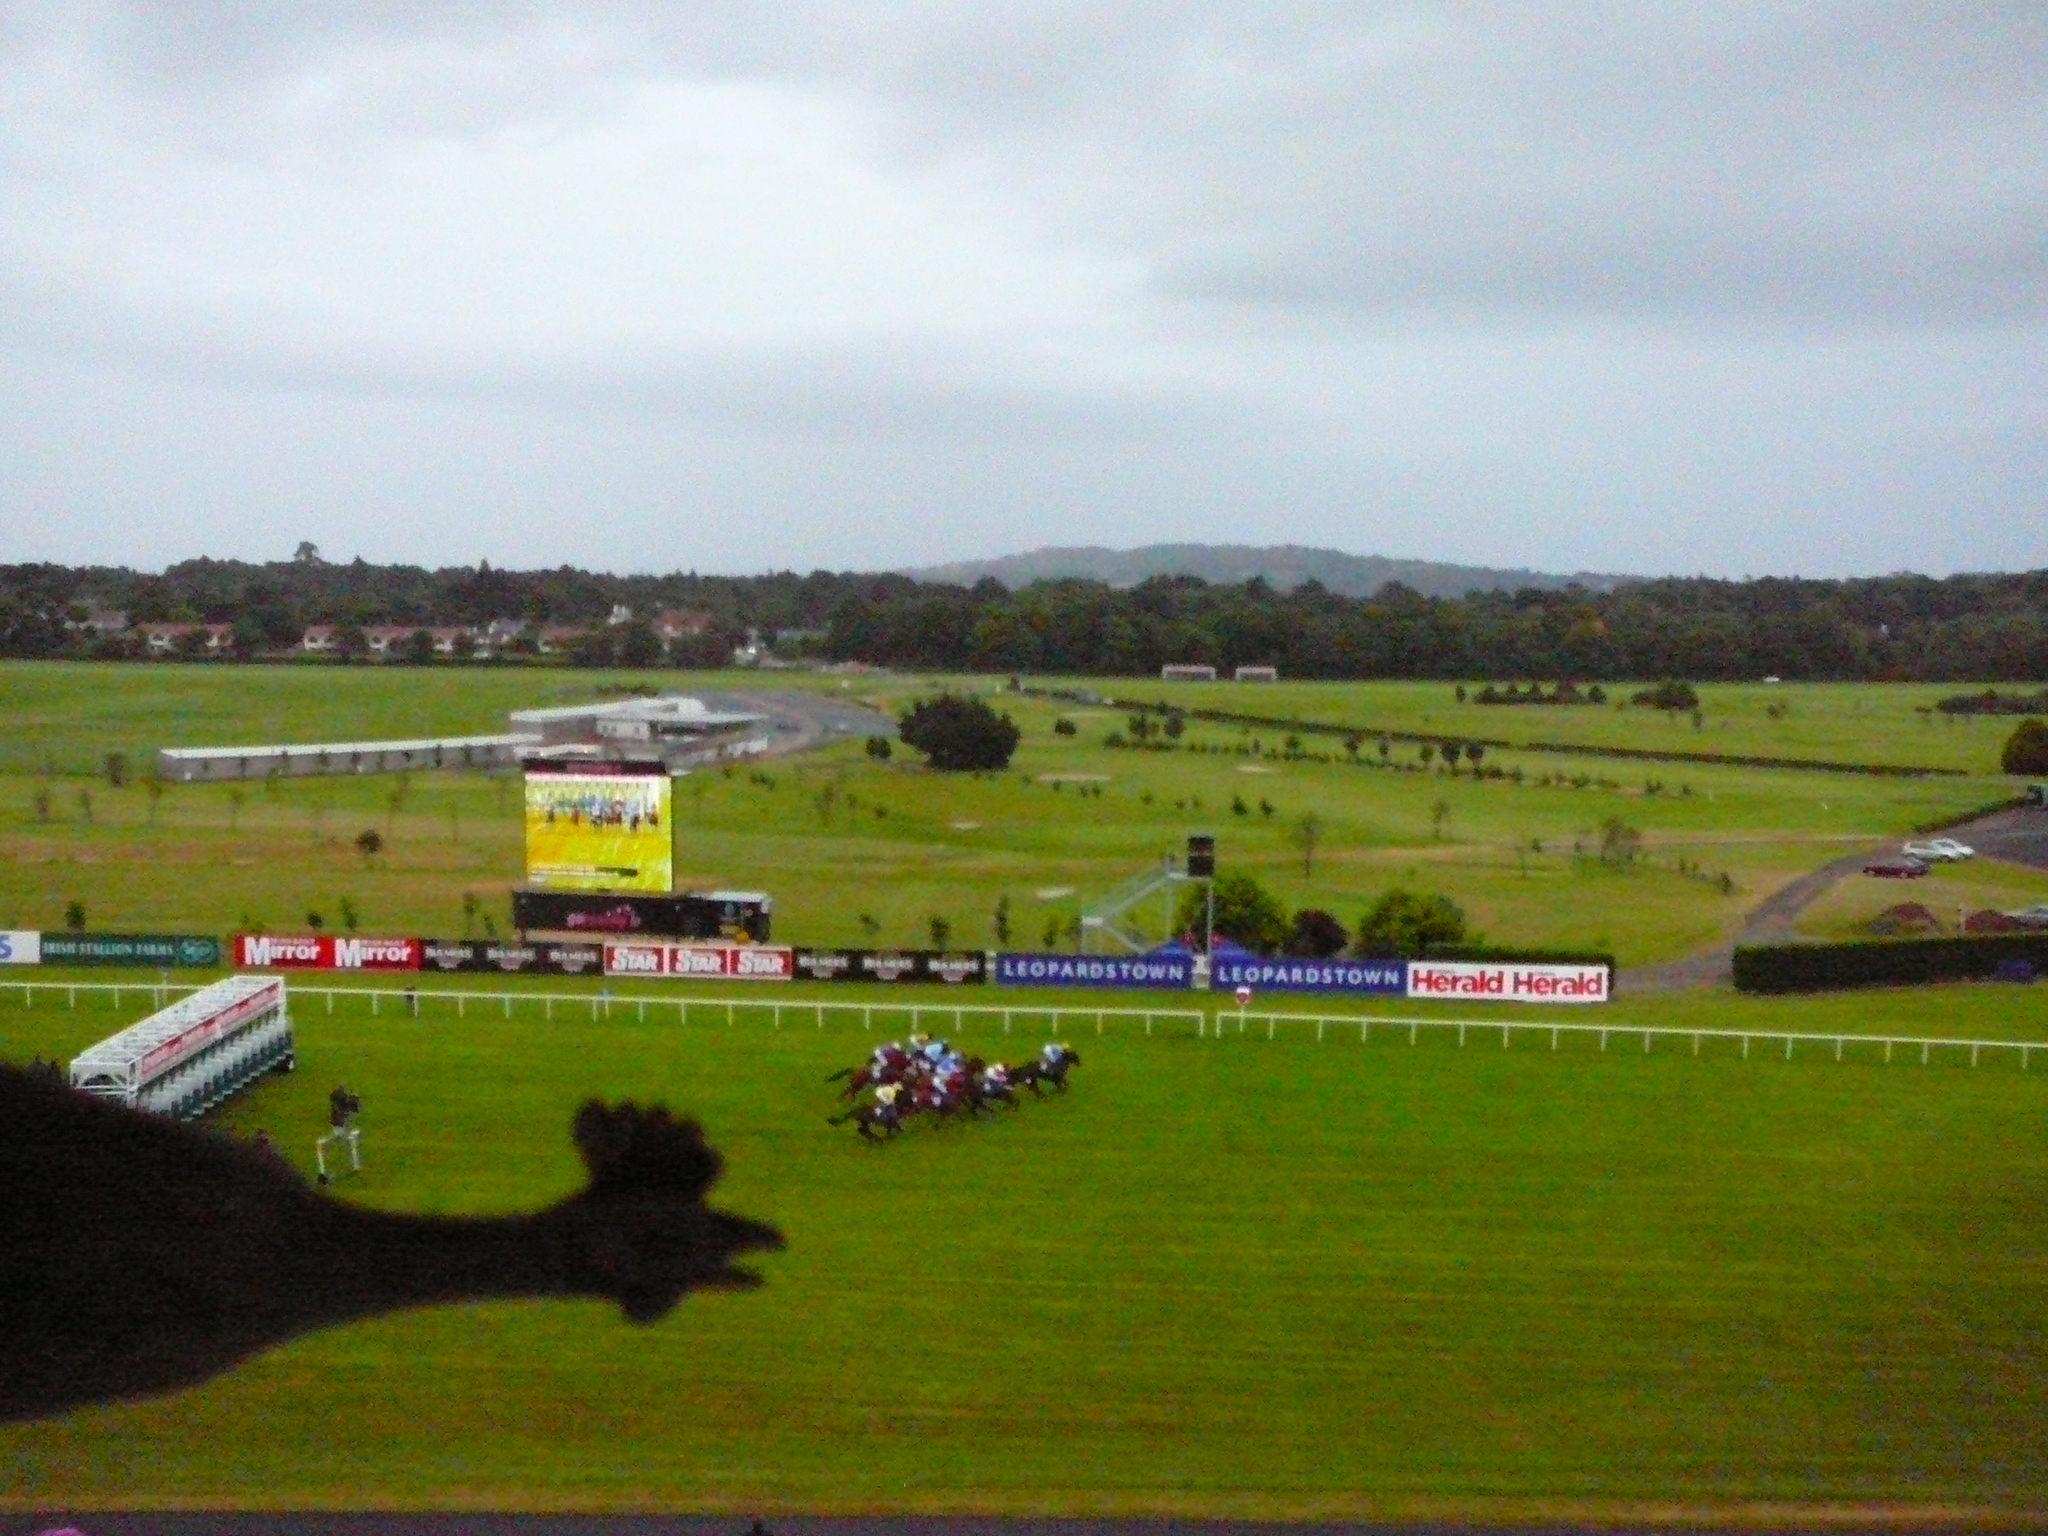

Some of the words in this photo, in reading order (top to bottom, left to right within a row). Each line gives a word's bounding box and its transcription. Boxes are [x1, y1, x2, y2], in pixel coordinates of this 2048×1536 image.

[244, 937, 320, 965] Mirror
[335, 938, 411, 967] Mirror
[1004, 960, 1184, 980] LEOPARDSTOWN
[1218, 964, 1400, 985] LEOPARDSTOWN
[1412, 969, 1504, 993] Herald
[1512, 971, 1603, 995] Herald
